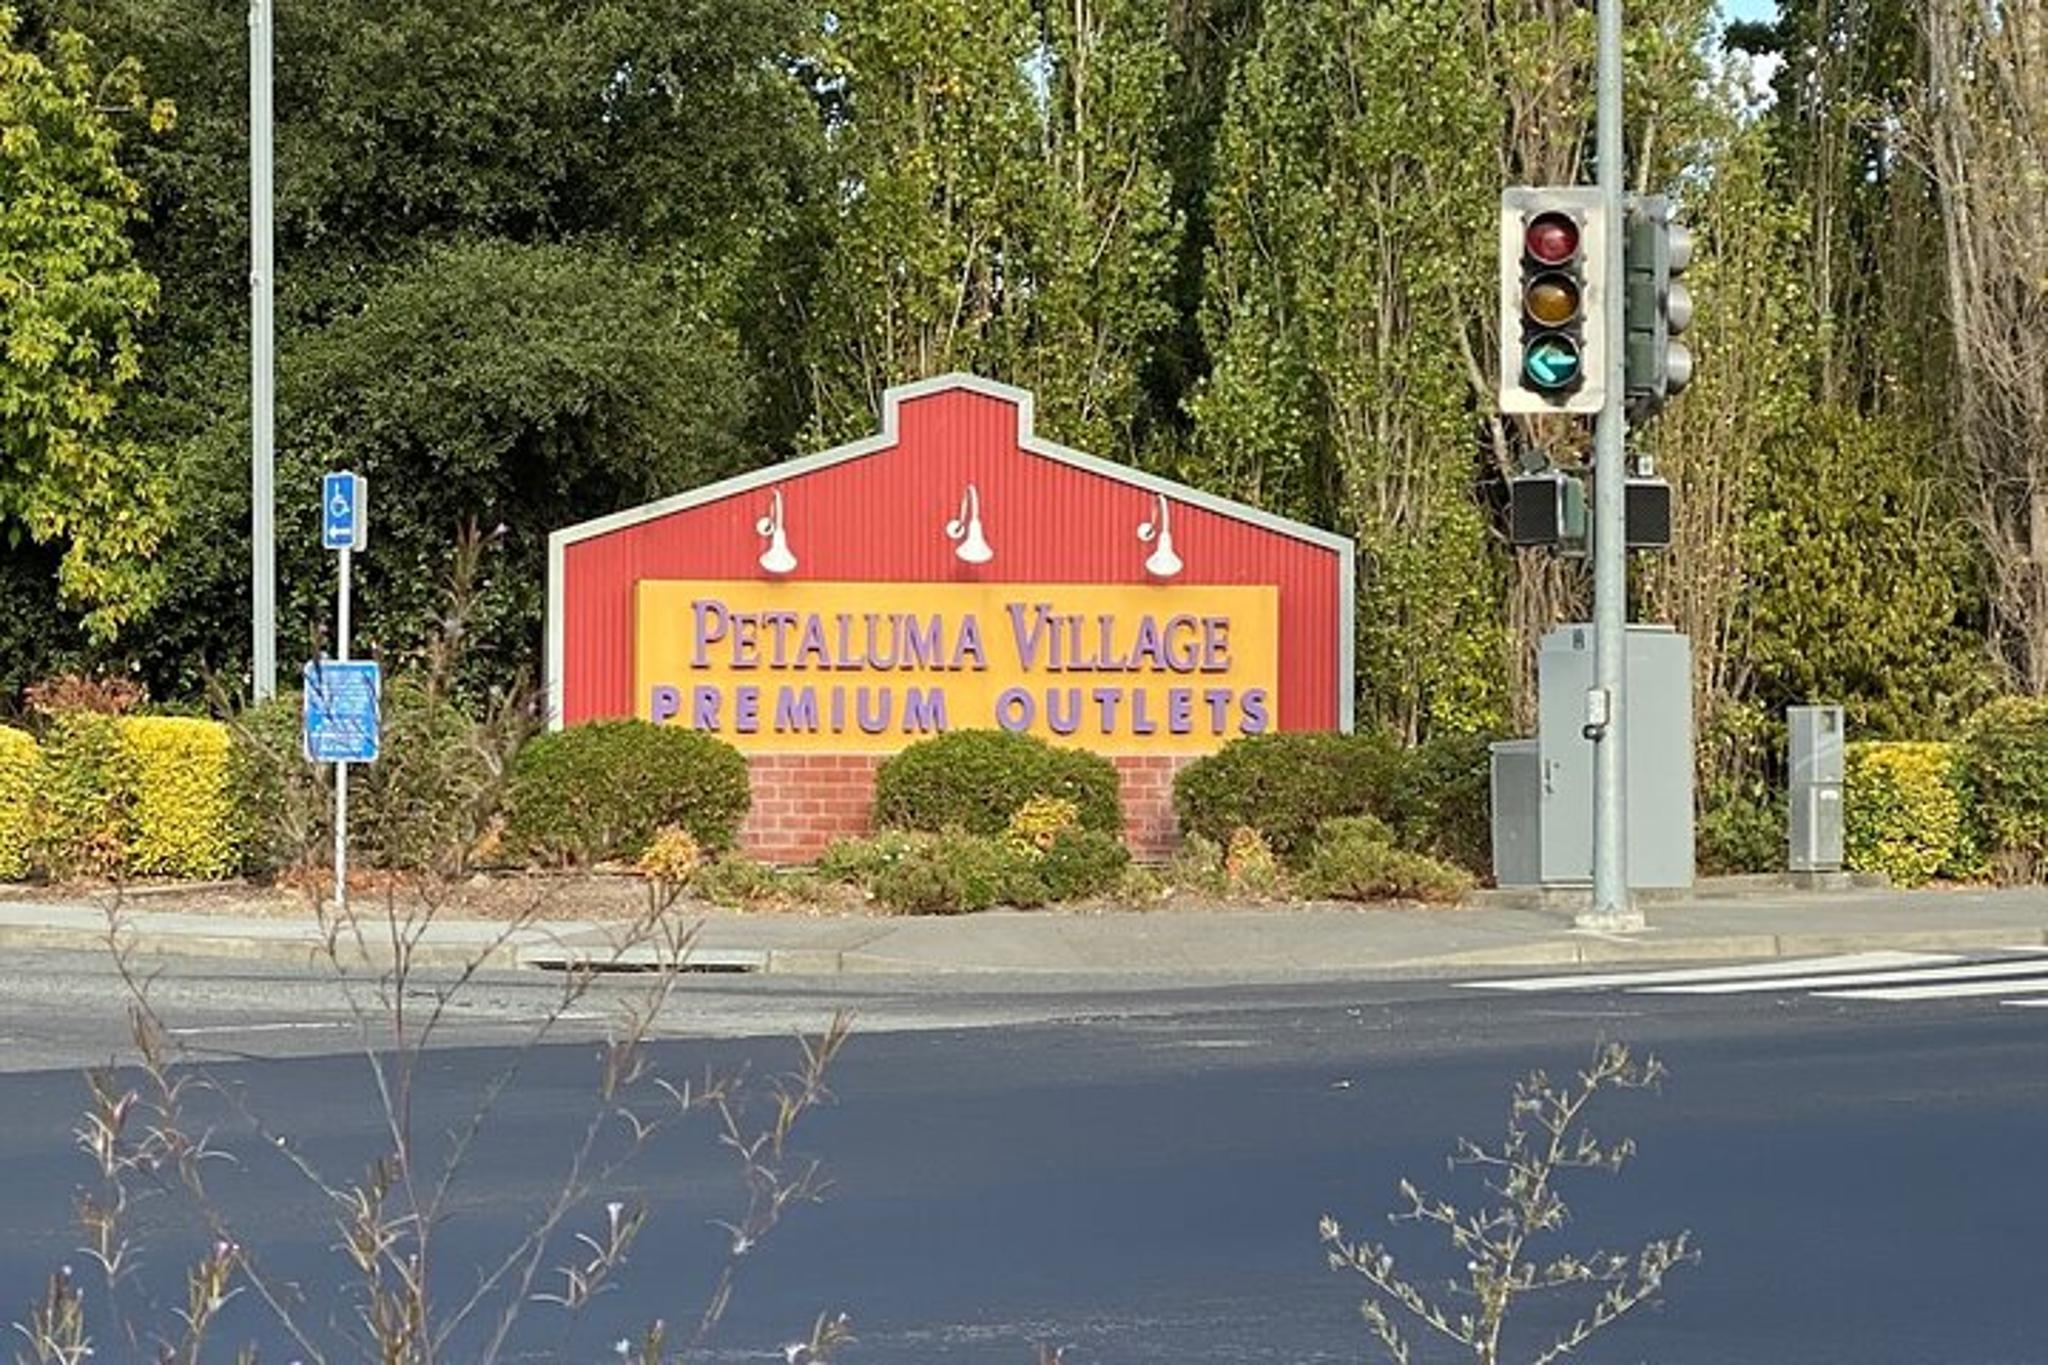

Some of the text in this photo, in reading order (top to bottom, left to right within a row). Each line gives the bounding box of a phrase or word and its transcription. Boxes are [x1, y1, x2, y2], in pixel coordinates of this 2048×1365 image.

[691, 600, 1231, 674] PETALUMA VILLAGE
[650, 686, 1269, 734] PREMIUM OUTLETS
